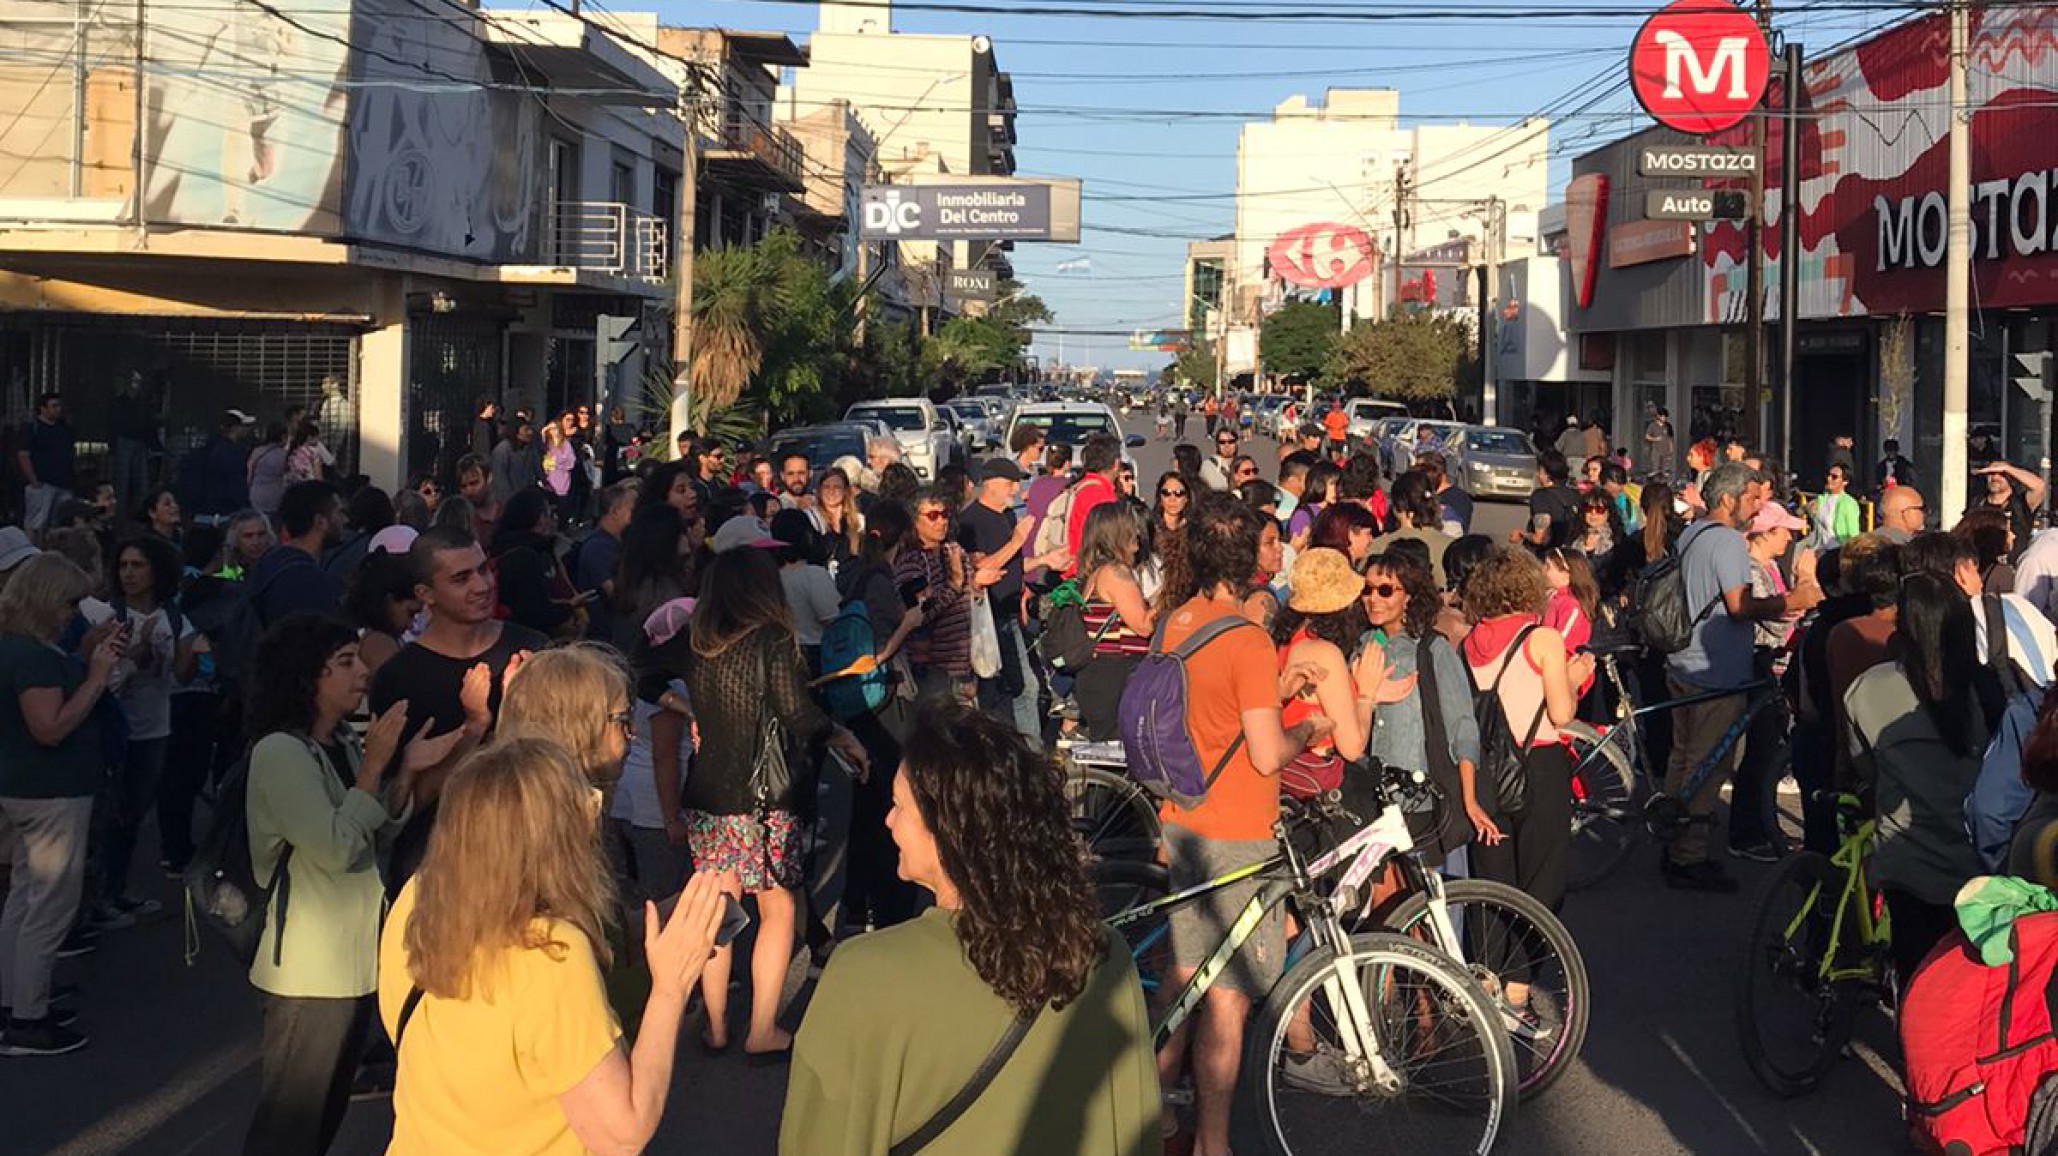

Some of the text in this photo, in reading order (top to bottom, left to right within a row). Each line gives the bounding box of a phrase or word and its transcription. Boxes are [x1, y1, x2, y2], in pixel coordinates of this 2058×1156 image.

[1655, 29, 1750, 99] M
[936, 192, 1026, 207] Inmobiliaria
[1661, 196, 1713, 212] Auto
[940, 208, 1020, 224] Del Centro
[953, 275, 990, 289] ROXI
